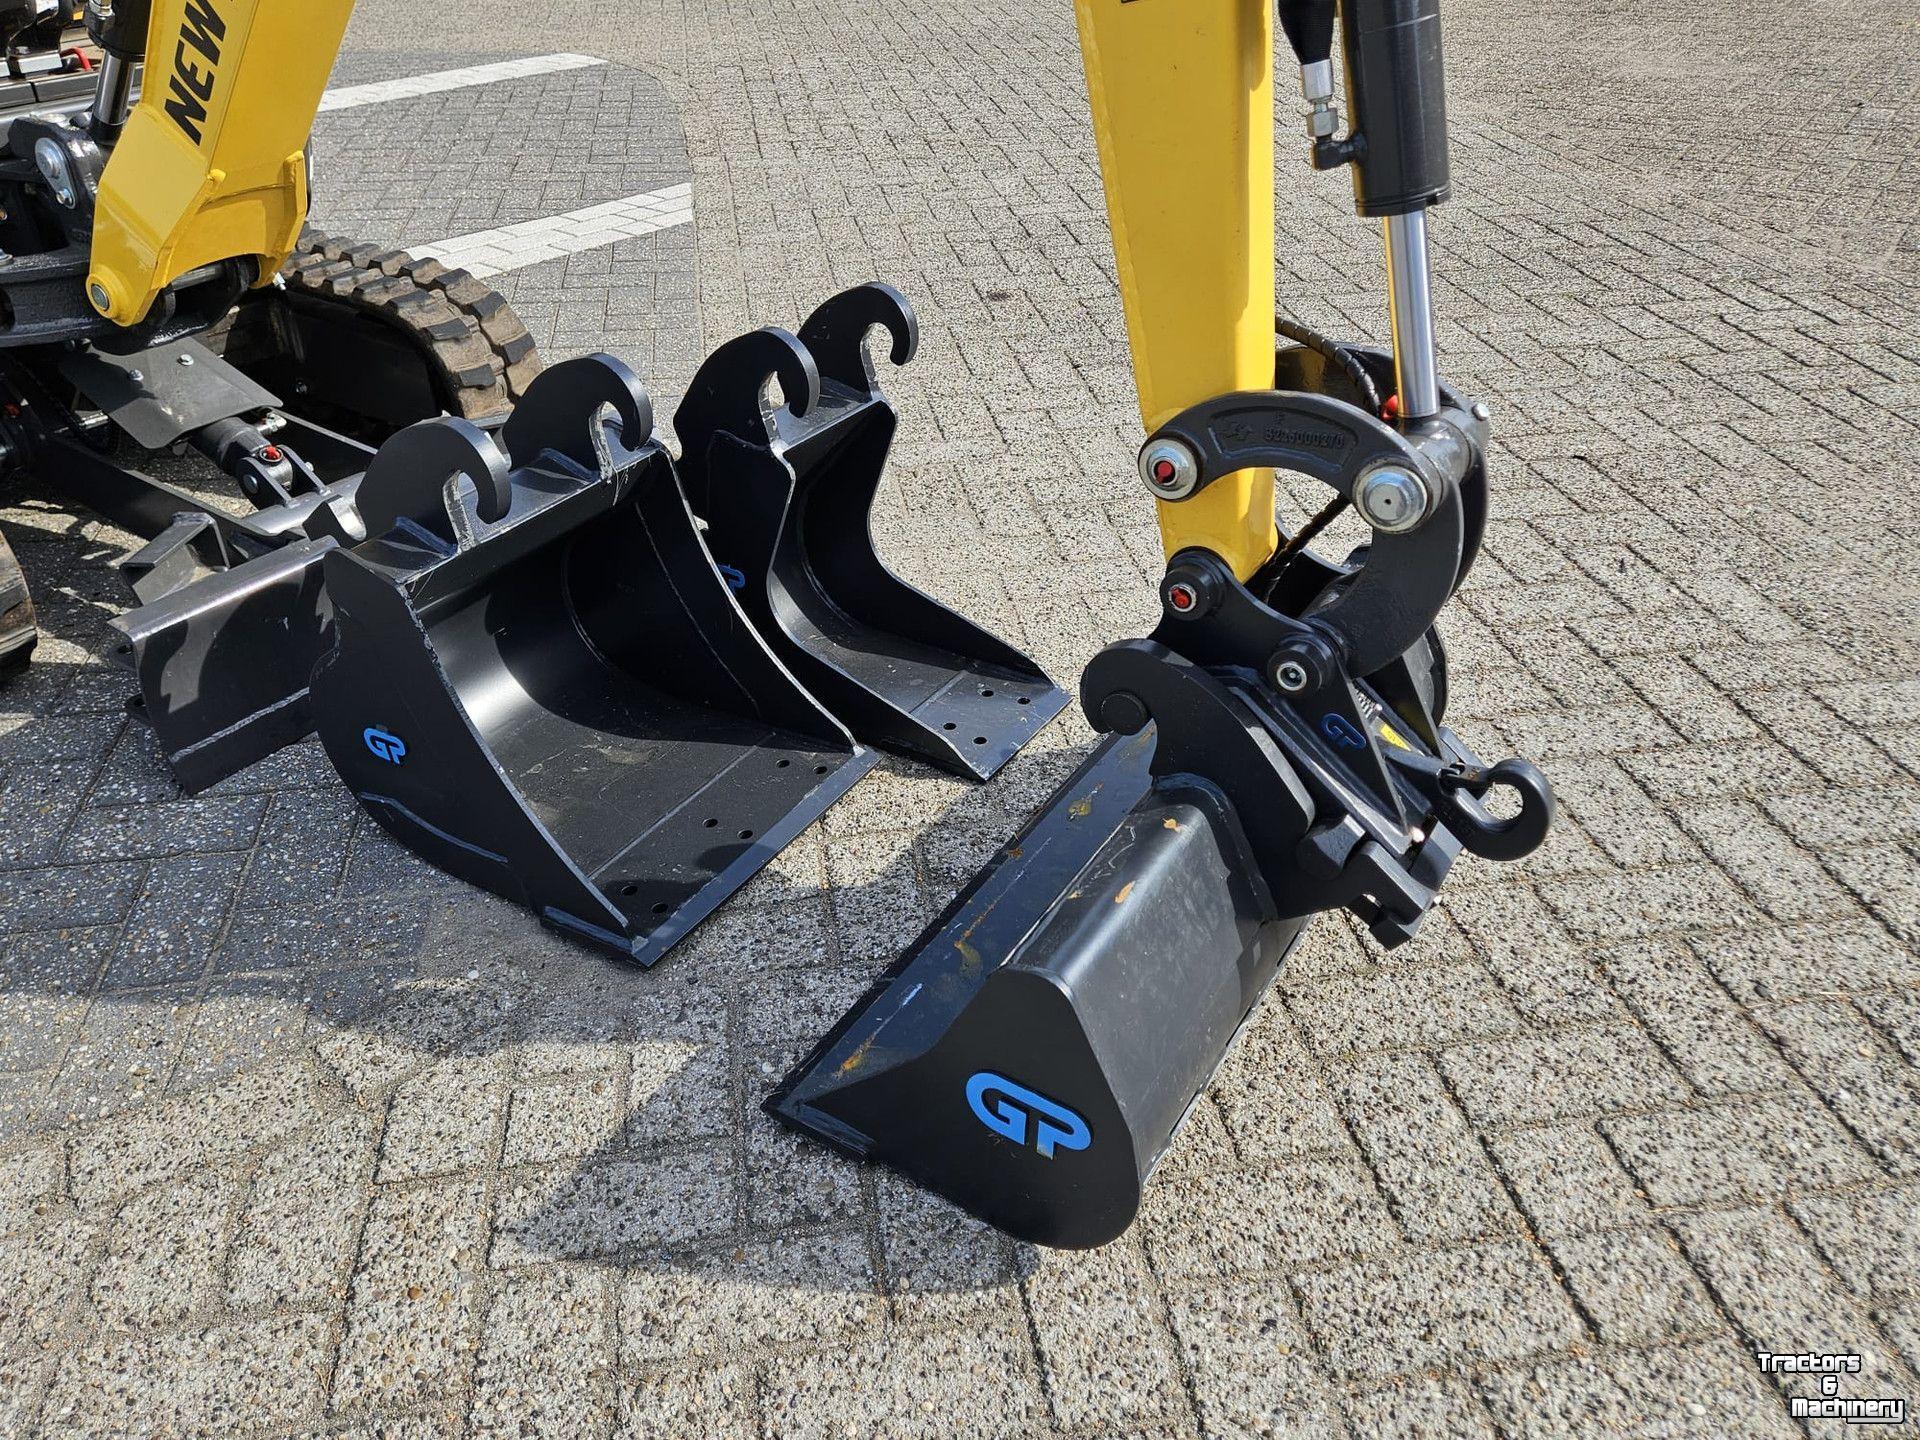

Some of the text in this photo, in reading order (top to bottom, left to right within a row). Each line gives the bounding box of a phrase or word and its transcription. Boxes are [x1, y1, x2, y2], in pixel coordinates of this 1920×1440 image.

[164, 0, 226, 147] NEW
[363, 727, 406, 765] GP
[965, 1072, 1092, 1161] GP
